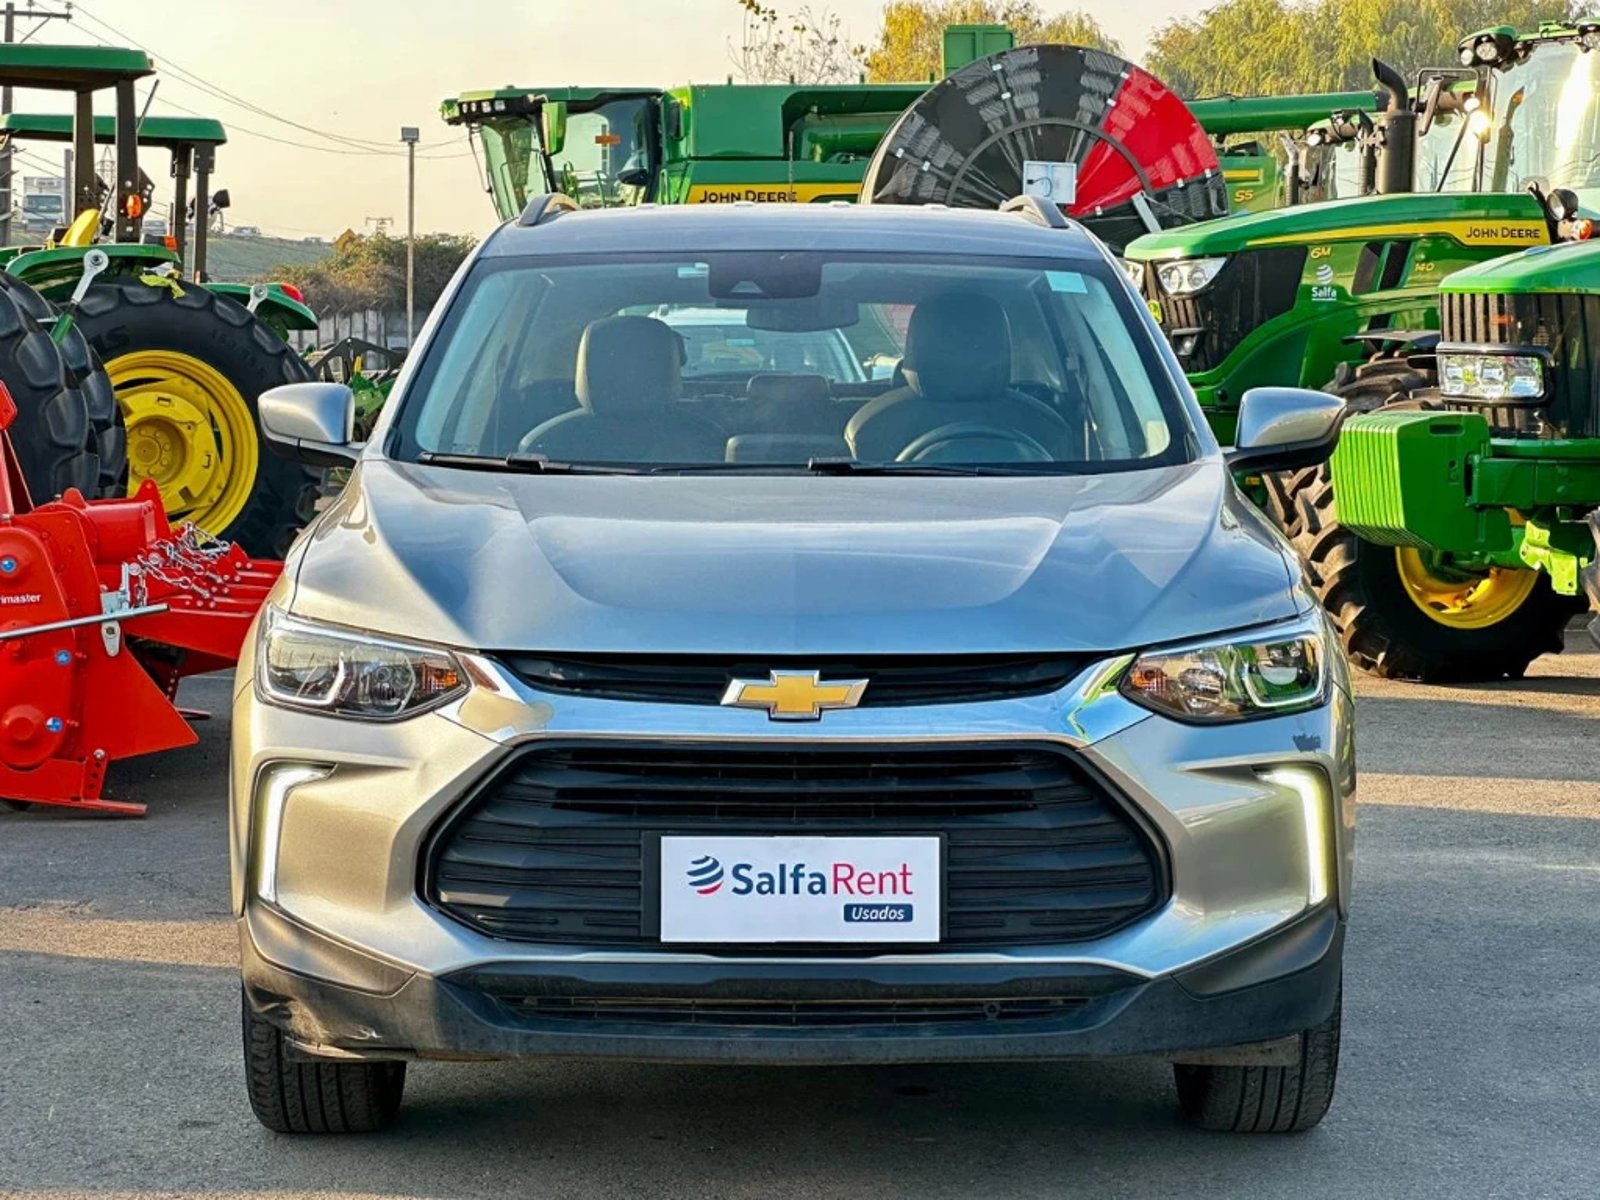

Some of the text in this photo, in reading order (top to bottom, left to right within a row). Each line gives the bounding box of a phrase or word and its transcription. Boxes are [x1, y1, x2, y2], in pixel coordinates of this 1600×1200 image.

[699, 190, 797, 203] JOHN DEERE
[1466, 226, 1540, 238] JOHN DEERE
[1310, 246, 1332, 259] 6M
[1311, 286, 1337, 297] Salfa
[731, 862, 914, 896] SalfaRent
[851, 905, 905, 921] Usados
